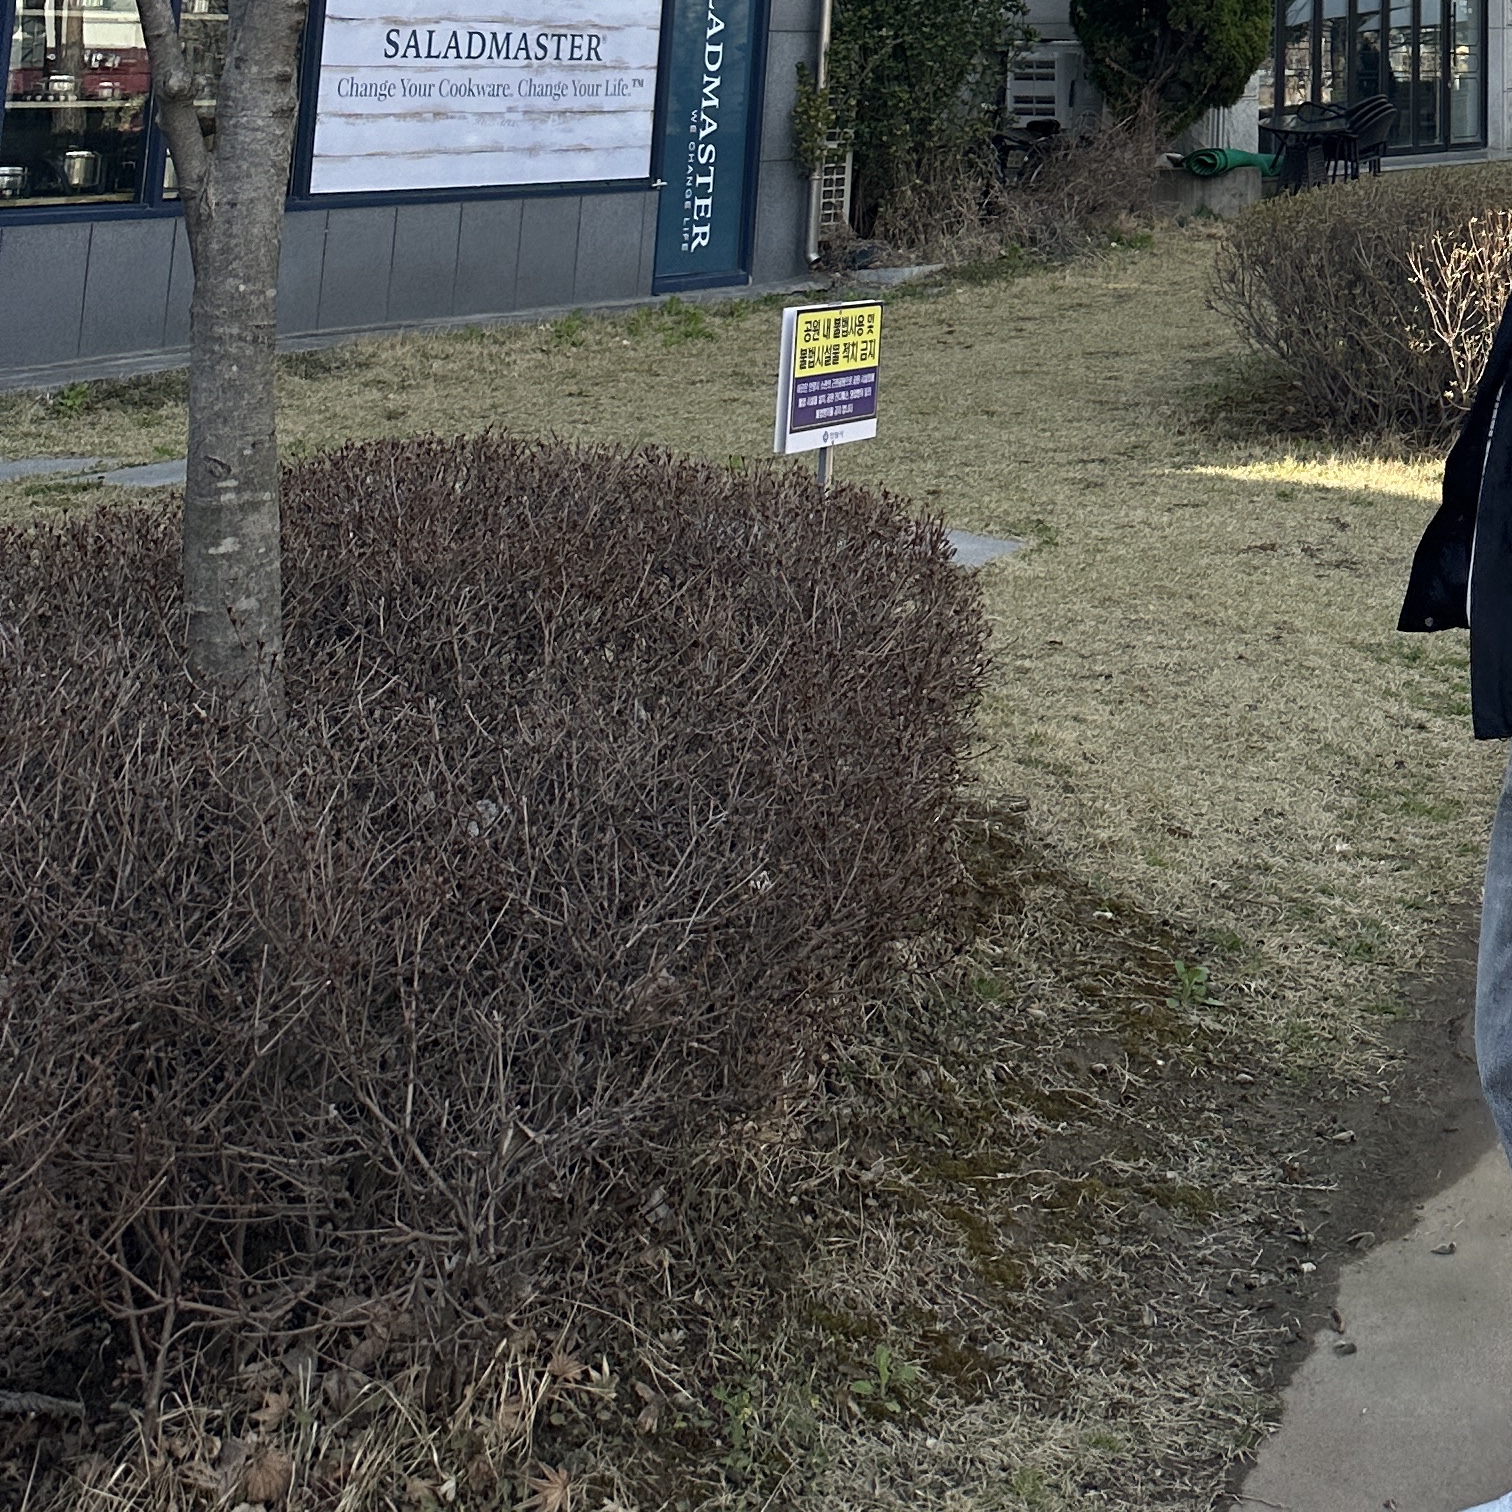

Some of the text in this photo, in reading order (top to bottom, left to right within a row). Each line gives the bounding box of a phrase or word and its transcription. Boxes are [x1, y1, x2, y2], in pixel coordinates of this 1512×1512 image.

[337, 77, 396, 101] Change
[400, 78, 436, 98] Your
[439, 78, 514, 98] Cookware.
[518, 78, 568, 101] Change
[572, 79, 602, 97] Your
[681, 109, 698, 252] WE CHANGE LIFE
[804, 313, 875, 343] 공원 내 불법사용 및
[800, 339, 876, 370] 불법시설물 적치 금지
